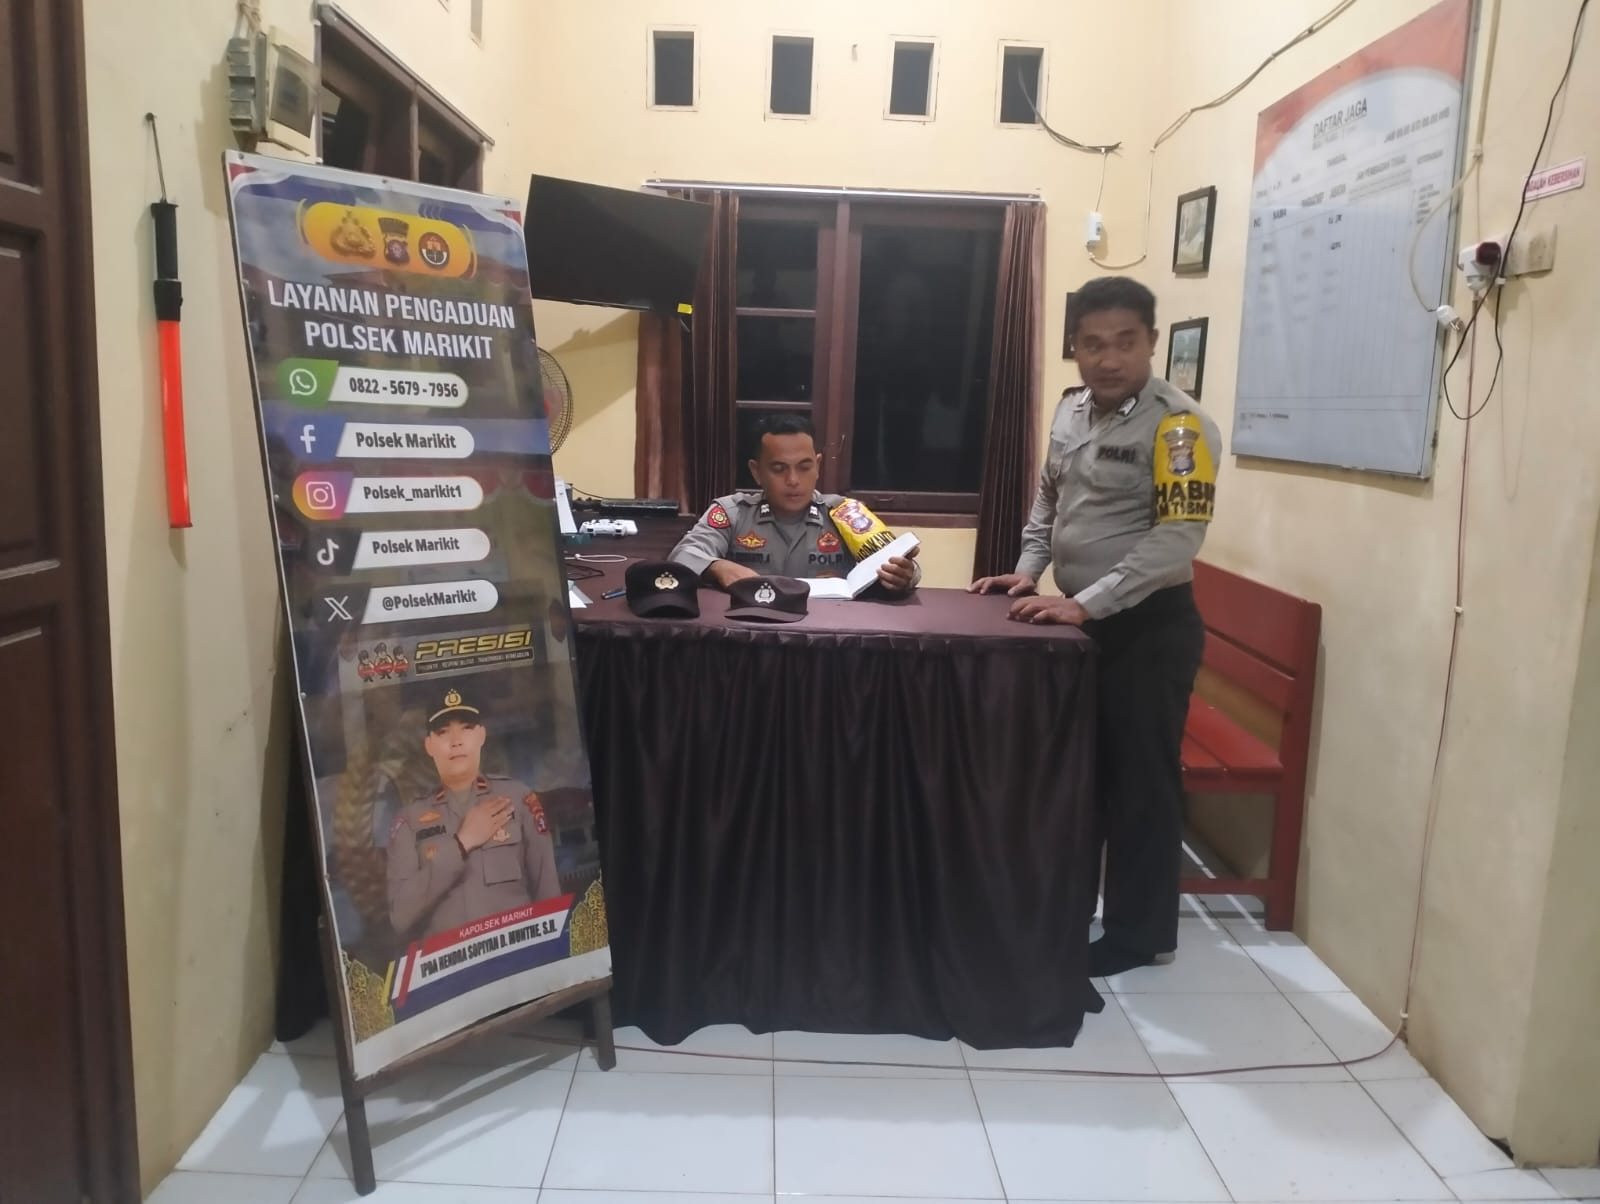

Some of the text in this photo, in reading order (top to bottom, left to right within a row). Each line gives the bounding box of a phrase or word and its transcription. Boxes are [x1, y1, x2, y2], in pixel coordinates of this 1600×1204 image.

[1312, 97, 1367, 138] DAFTAR JAGA
[267, 280, 516, 329] LAYANAN PENGADUAN
[304, 321, 493, 359] POLSEK MARIKIT
[356, 432, 457, 449] Polsek Marikit
[363, 485, 462, 502] Polsek_marikit1
[372, 536, 460, 554] Polsek Marikit
[382, 590, 477, 611] @PolsekMarikit
[415, 630, 533, 661] PRESISI
[459, 907, 534, 938] KAPOLSEK MARIKIT
[420, 958, 439, 978] IPDA
[438, 946, 467, 971] HENDRA
